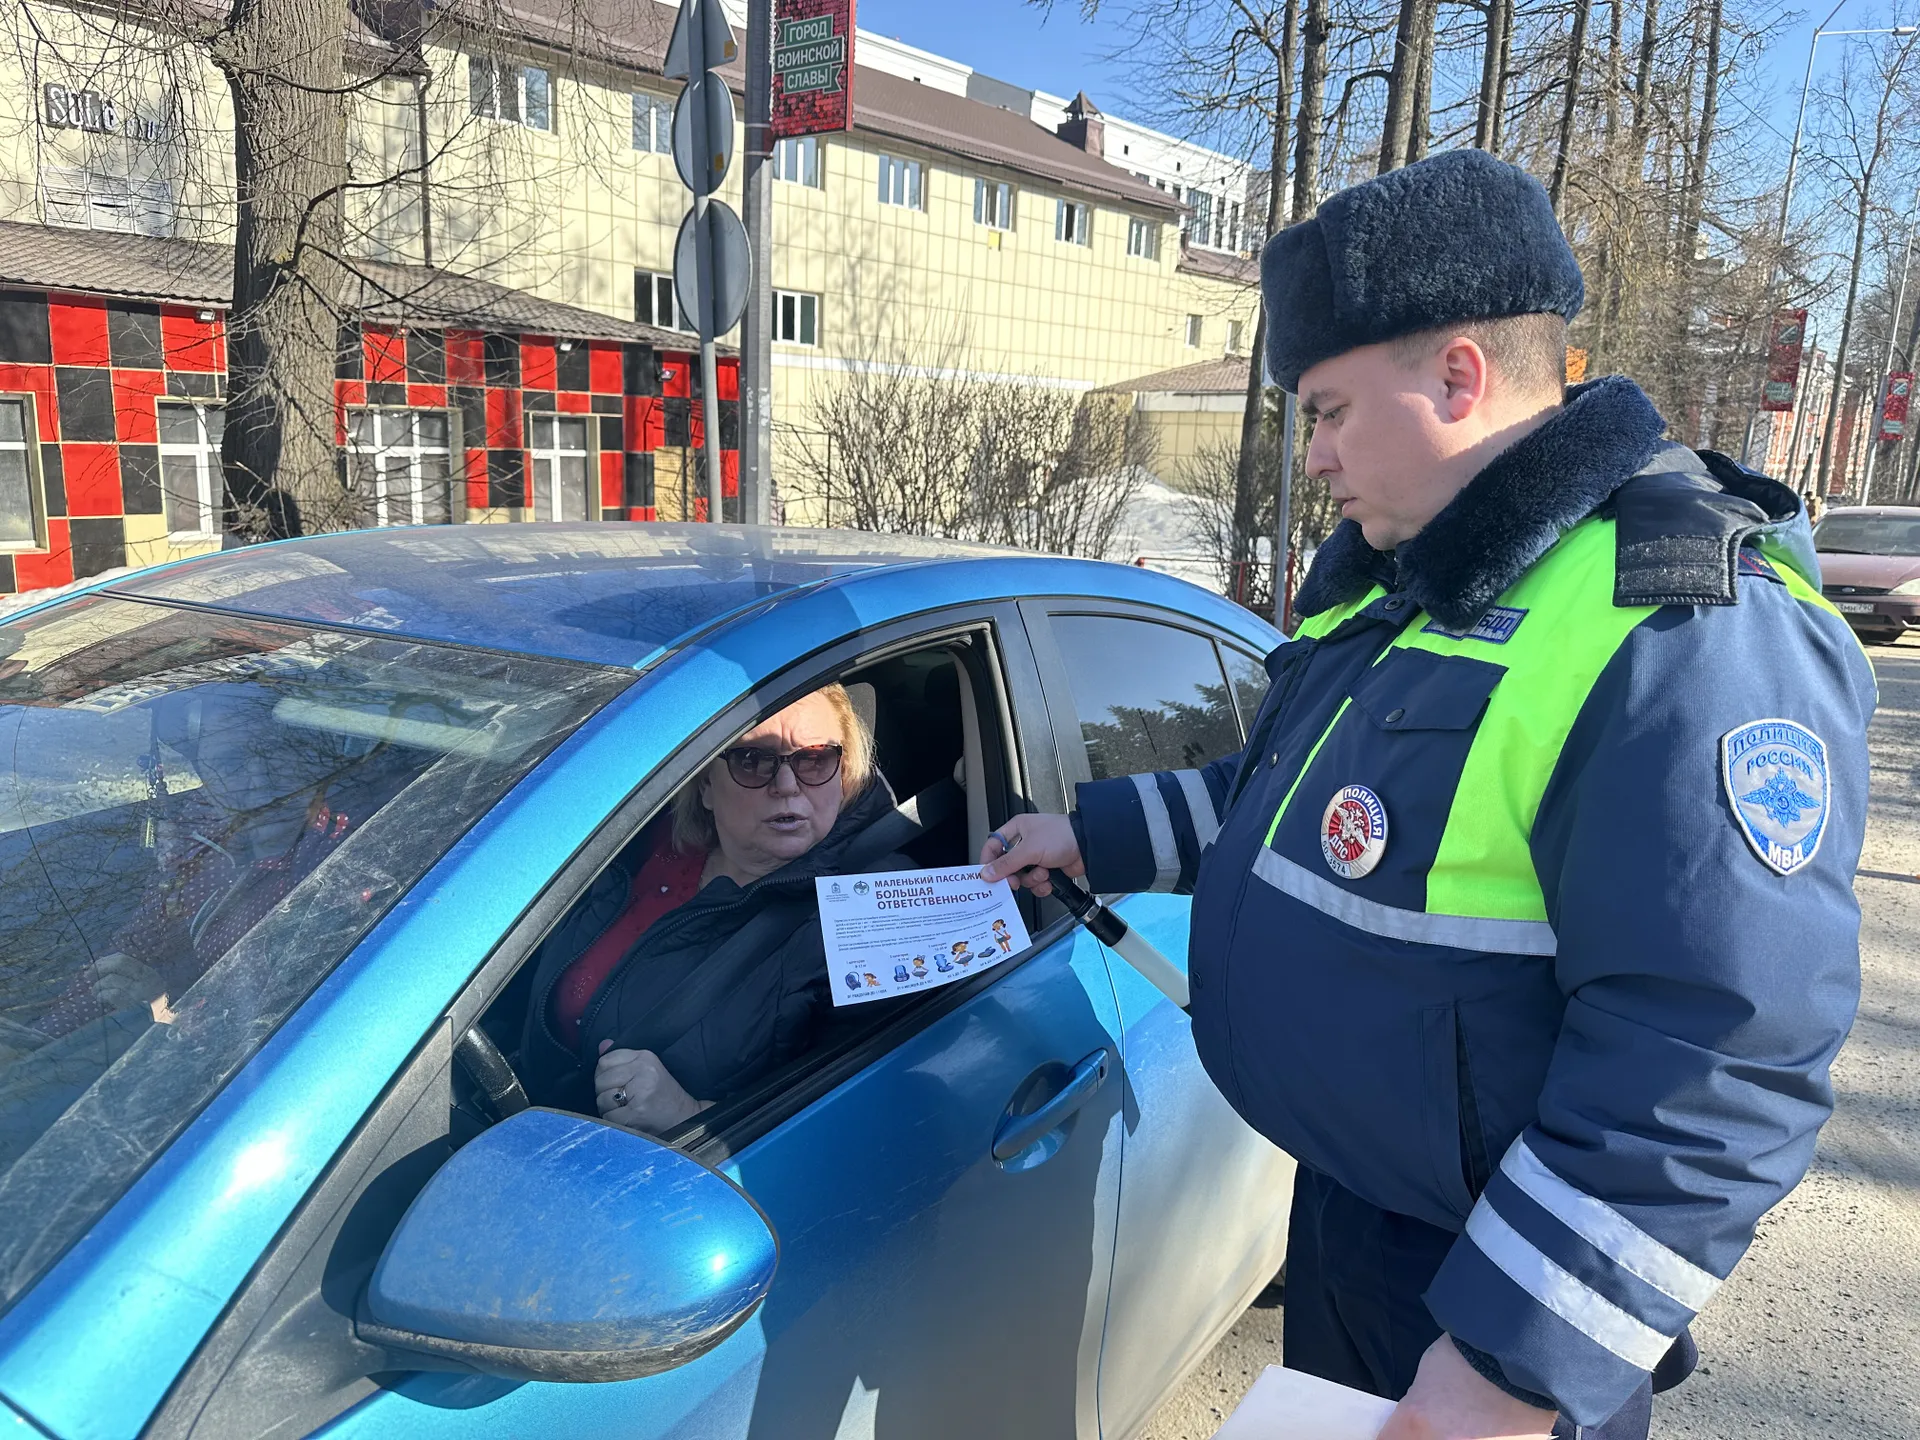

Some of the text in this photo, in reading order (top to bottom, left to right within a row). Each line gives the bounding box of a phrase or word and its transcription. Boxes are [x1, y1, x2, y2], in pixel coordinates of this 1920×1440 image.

[789, 21, 828, 42] ГОРОД
[777, 40, 840, 69] ВОИНСКОЙ
[787, 68, 828, 89] СЛАВЫ
[1478, 613, 1516, 635] БДД
[1733, 727, 1822, 762] ПОЛИЦИЯ
[1746, 750, 1814, 780] РОССИЯ
[1344, 788, 1383, 836] ПОЛИЦИЯ
[1329, 833, 1348, 859] ДПС
[1768, 840, 1804, 869] МВД
[874, 872, 982, 888] МАЛЕНЬКИЙ ПАССАЖИ
[875, 887, 934, 900] БОЛЬШАЯ
[877, 890, 993, 910] ОТВЕТСТВЕННОСТЬ!
